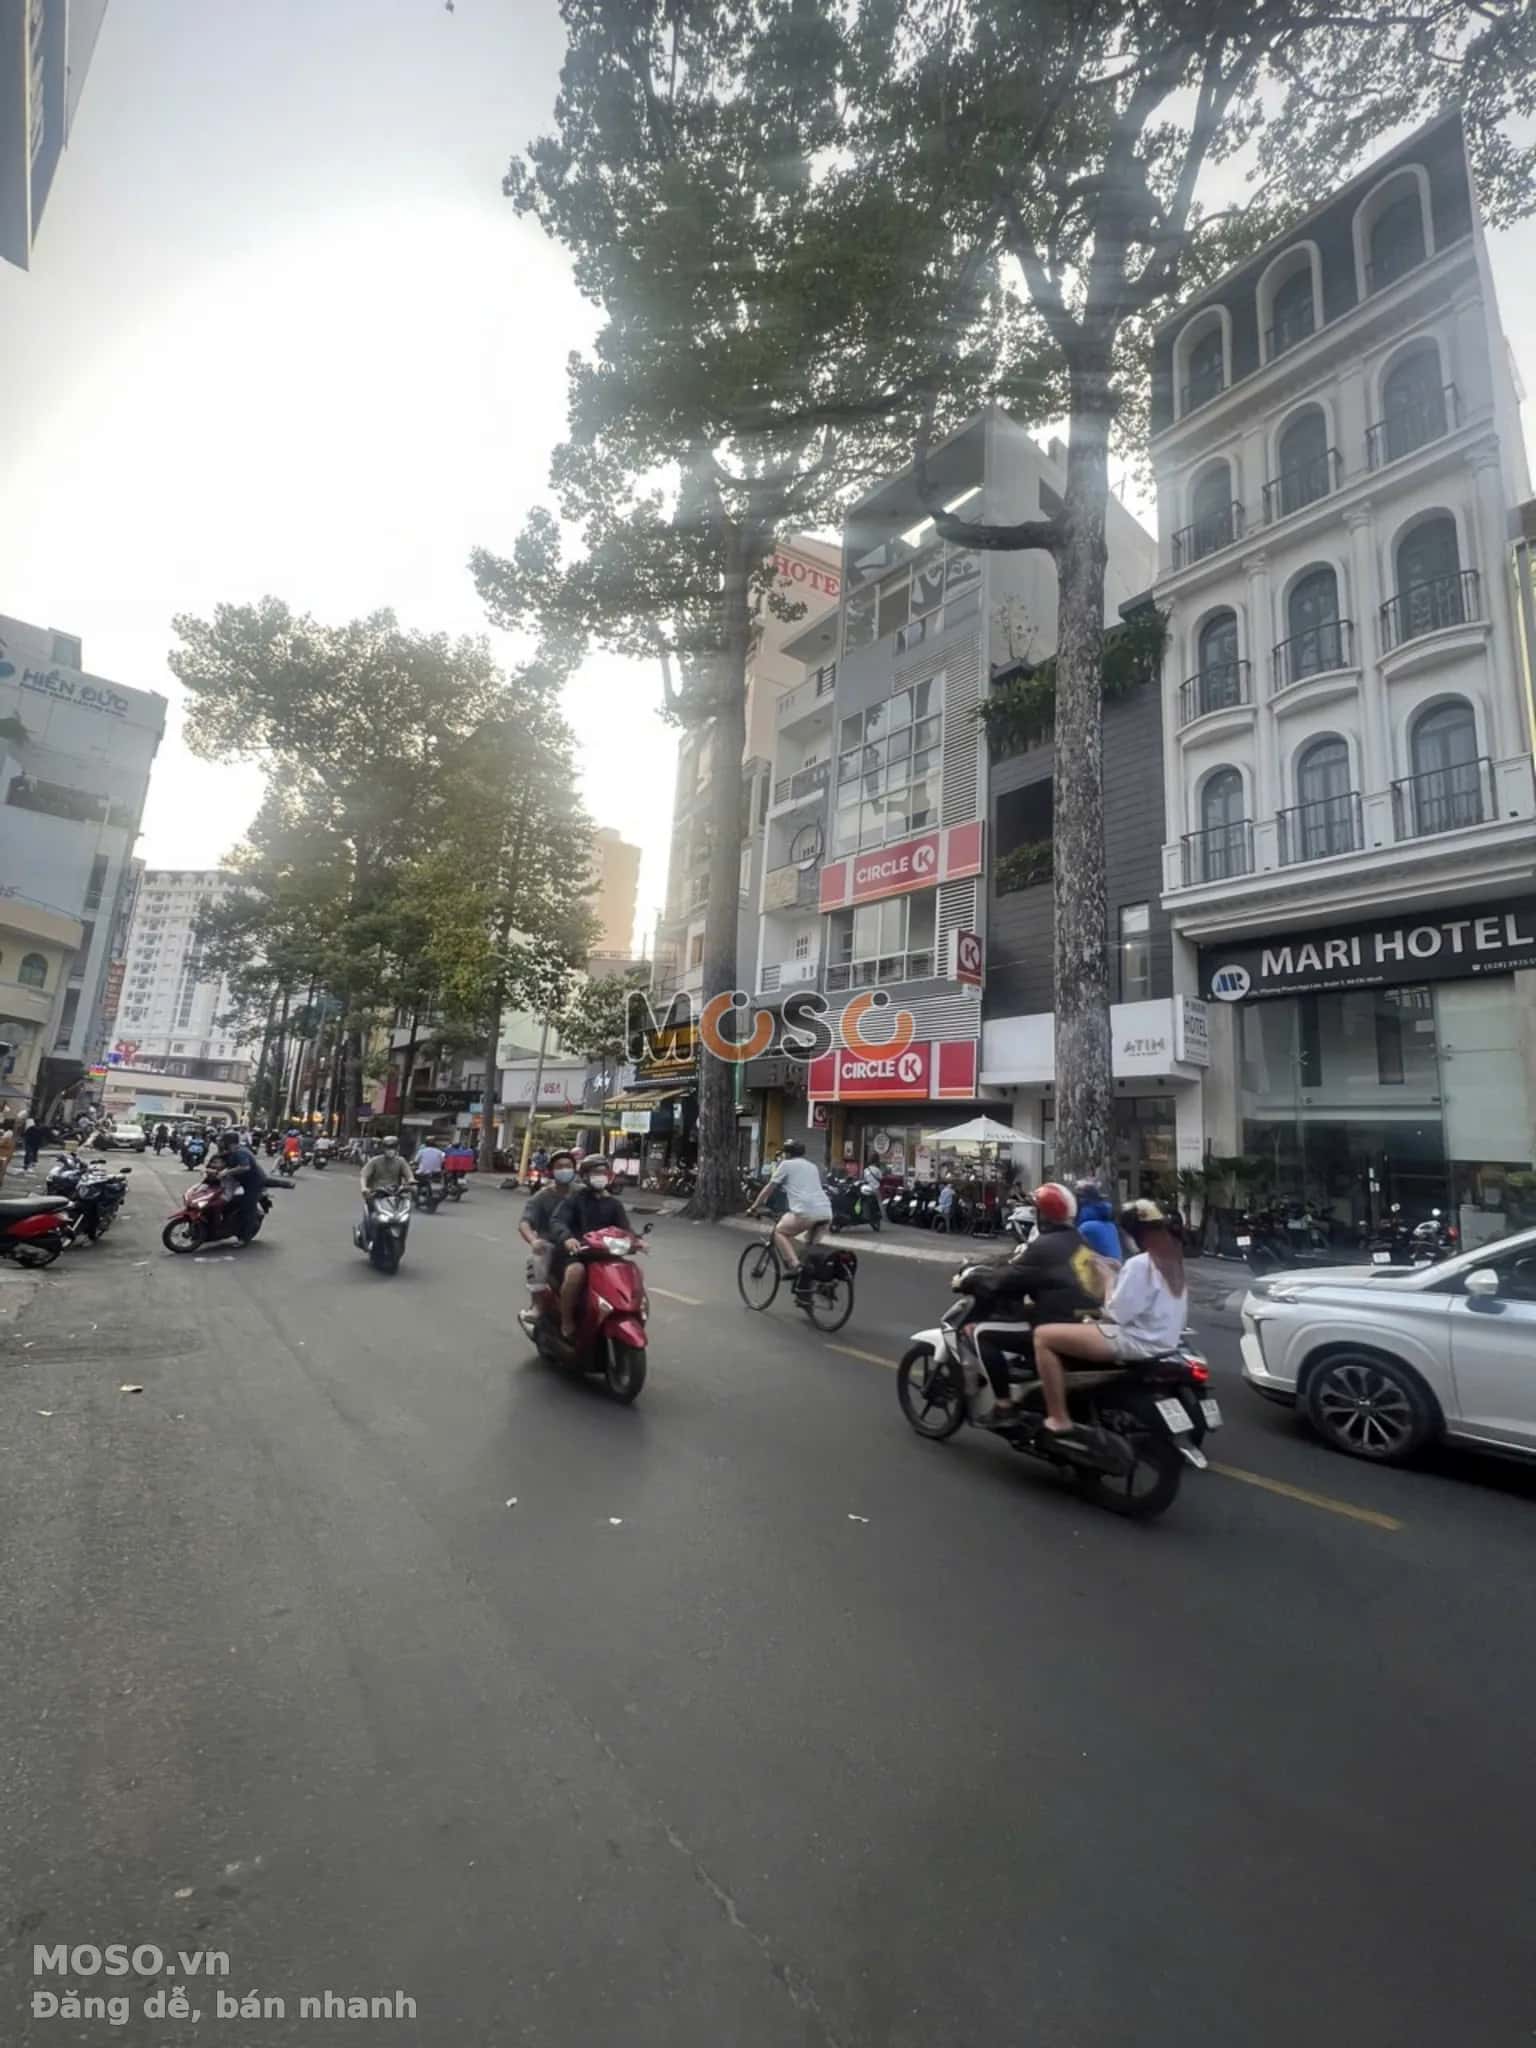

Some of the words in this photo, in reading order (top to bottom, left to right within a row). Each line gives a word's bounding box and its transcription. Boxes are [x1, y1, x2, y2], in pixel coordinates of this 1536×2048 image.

[856, 858, 909, 886] CIRCLE
[913, 846, 934, 872] K
[962, 940, 979, 969] K
[1261, 936, 1362, 977] MARI
[1375, 914, 1534, 963] HOTEL
[841, 1060, 896, 1080] CIRCLE
[899, 1053, 922, 1082] K
